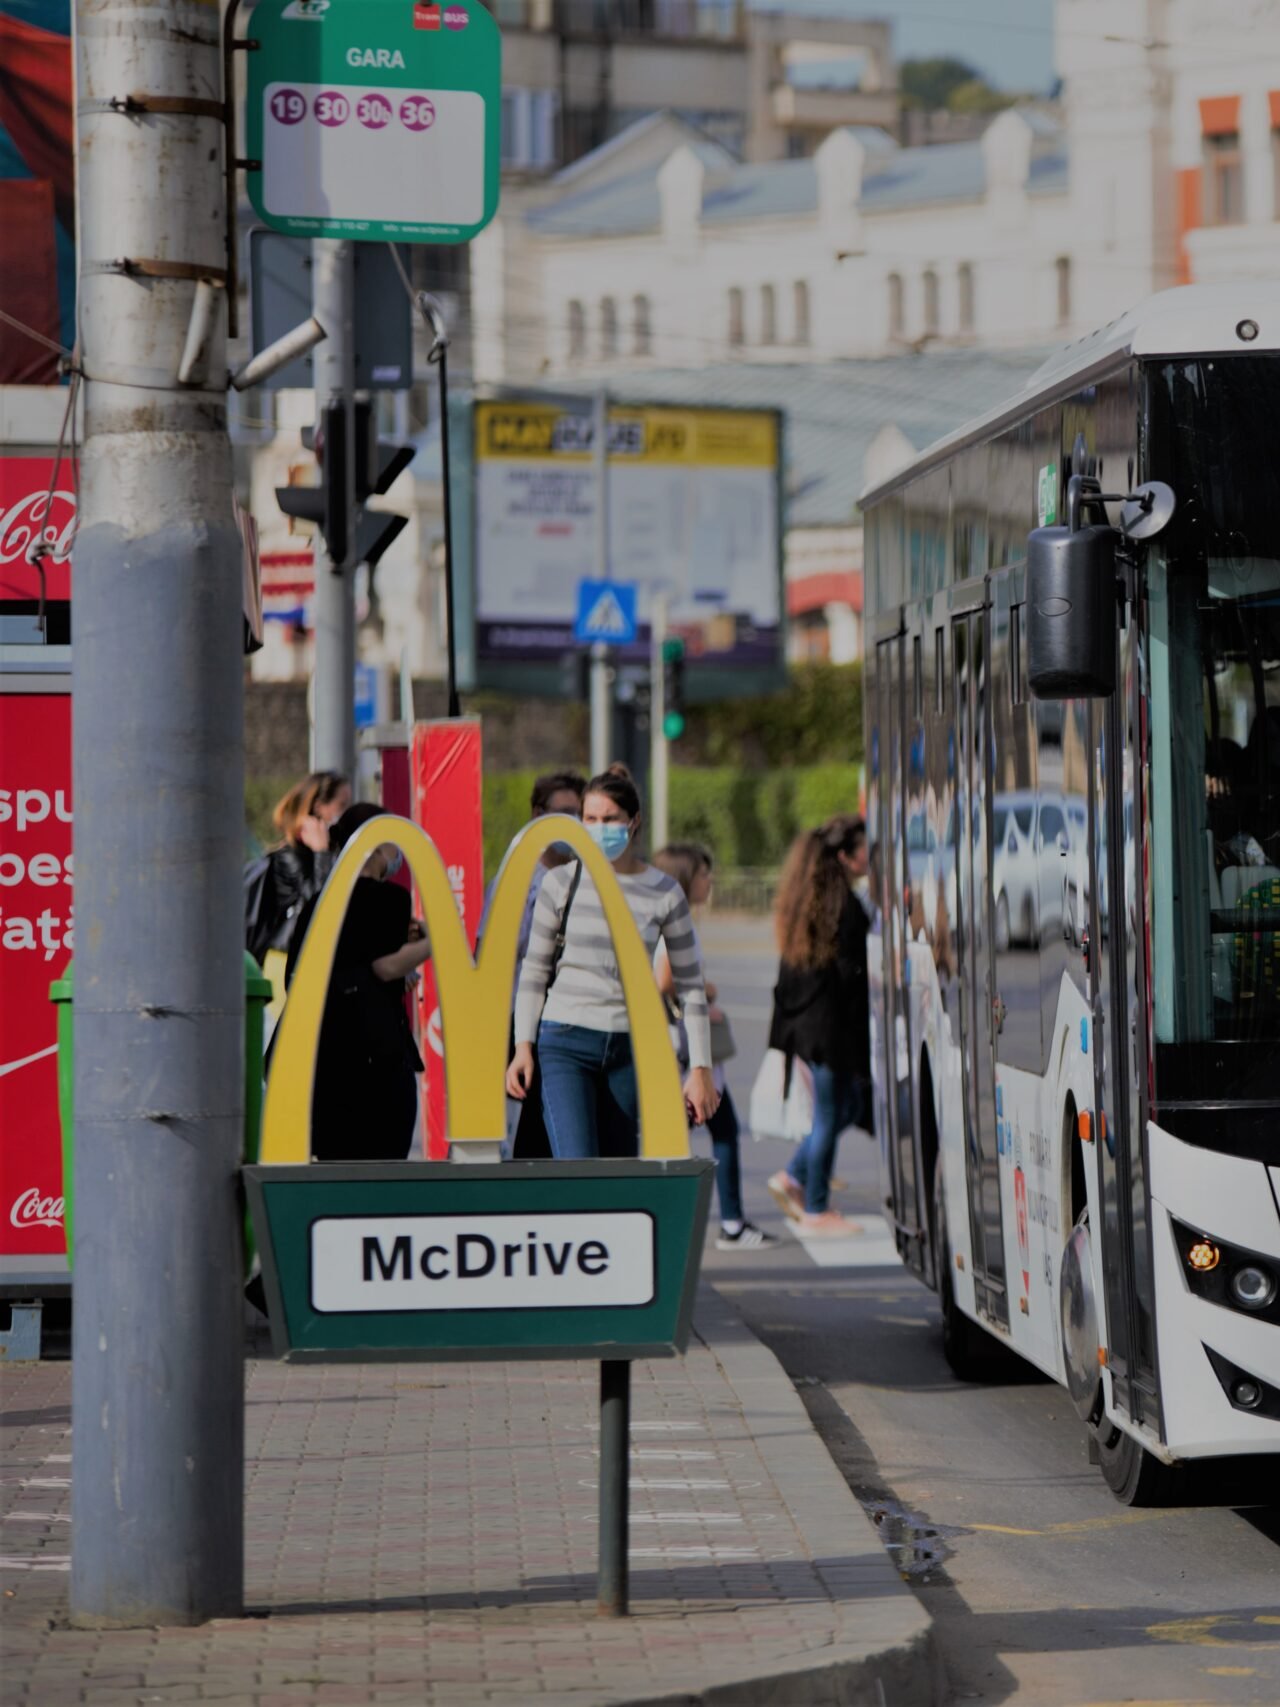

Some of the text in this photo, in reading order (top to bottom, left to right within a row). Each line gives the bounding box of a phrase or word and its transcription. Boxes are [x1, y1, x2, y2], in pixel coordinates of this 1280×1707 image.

[346, 47, 405, 69] GARA
[273, 95, 434, 125] 19 30 30b 36
[10, 1187, 65, 1228] Coca
[361, 1231, 610, 1282] McDrive
